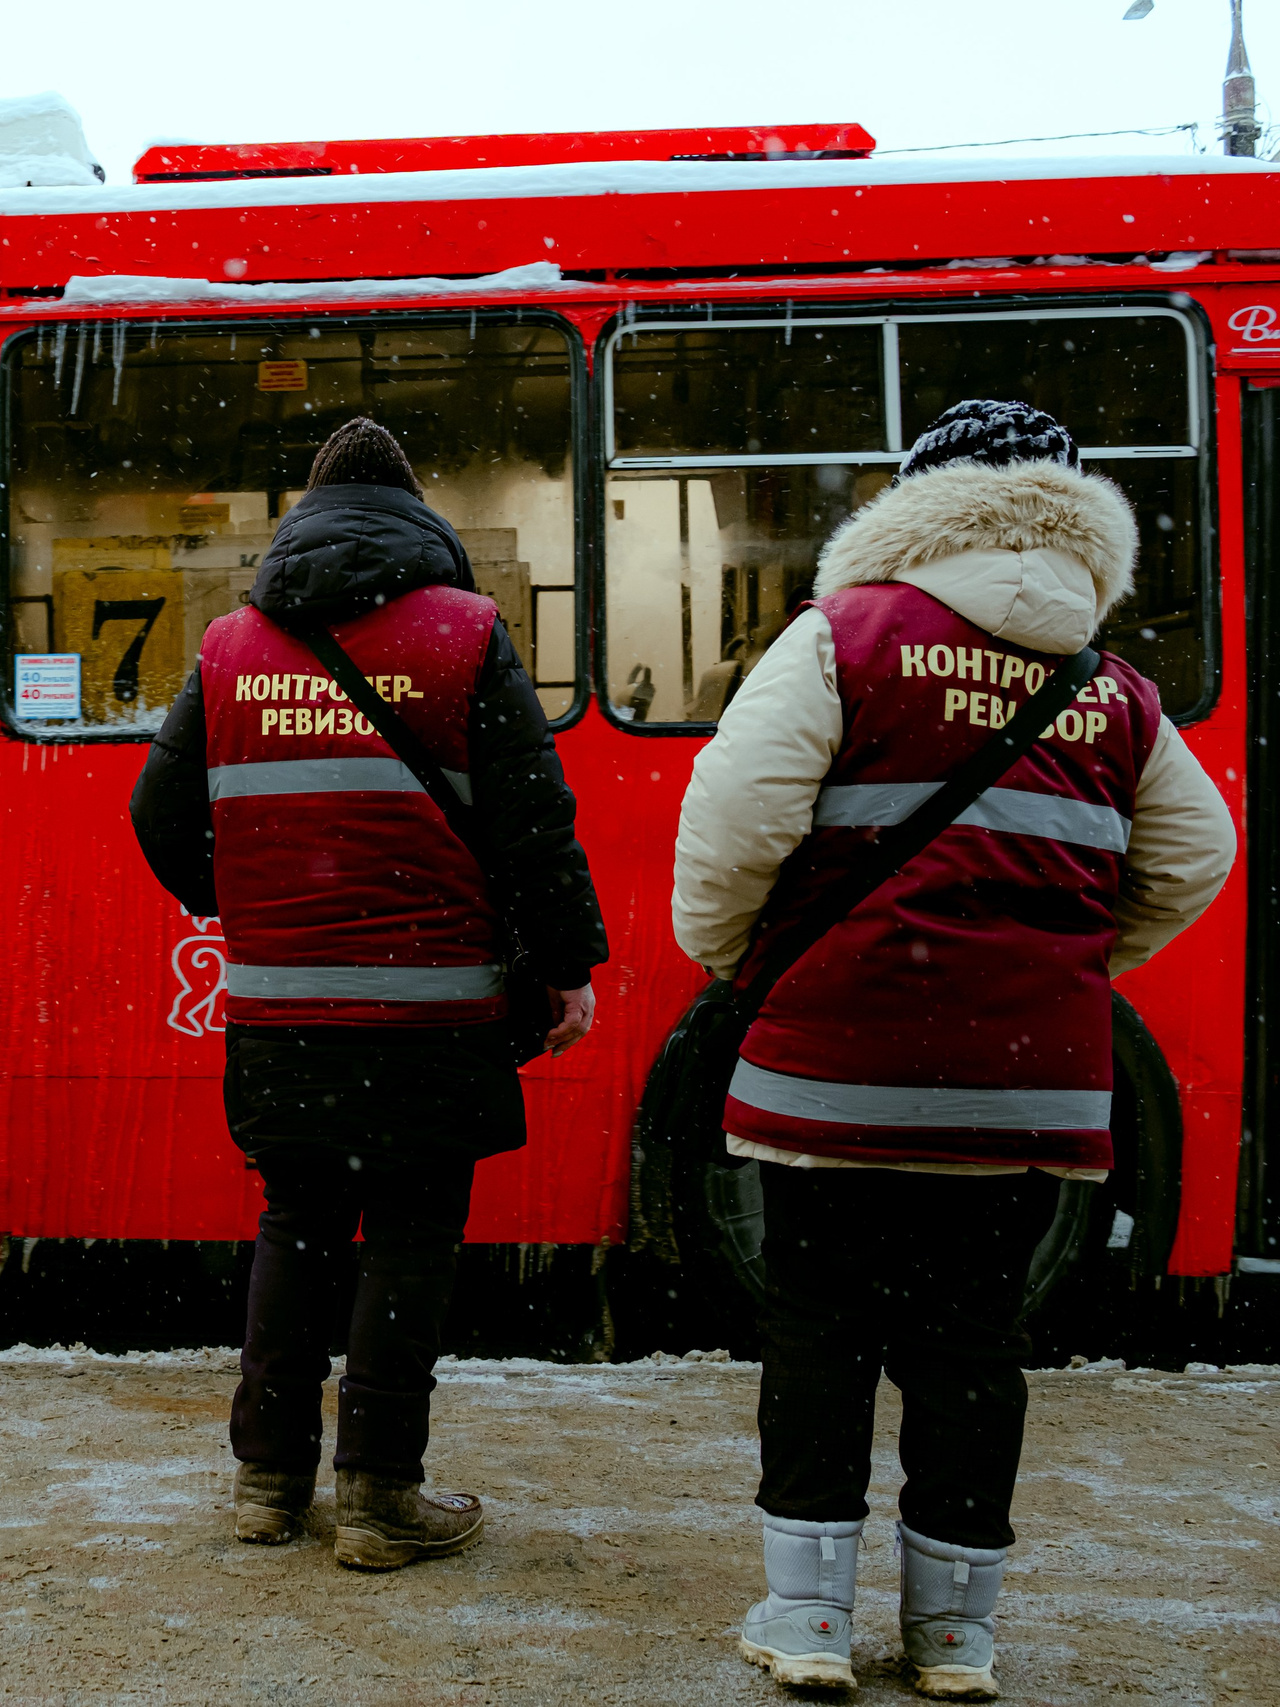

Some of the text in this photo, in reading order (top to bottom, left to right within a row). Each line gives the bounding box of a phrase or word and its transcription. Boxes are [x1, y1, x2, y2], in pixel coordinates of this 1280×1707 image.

[92, 596, 166, 703] 7
[21, 672, 41, 683] 40
[235, 674, 425, 702] КОНТРОЕР-
[900, 644, 1129, 705] КОНТРОЕР-
[21, 689, 41, 700] 40
[261, 708, 383, 737] РЕВИЗО
[944, 688, 1108, 744] РЕВОР
